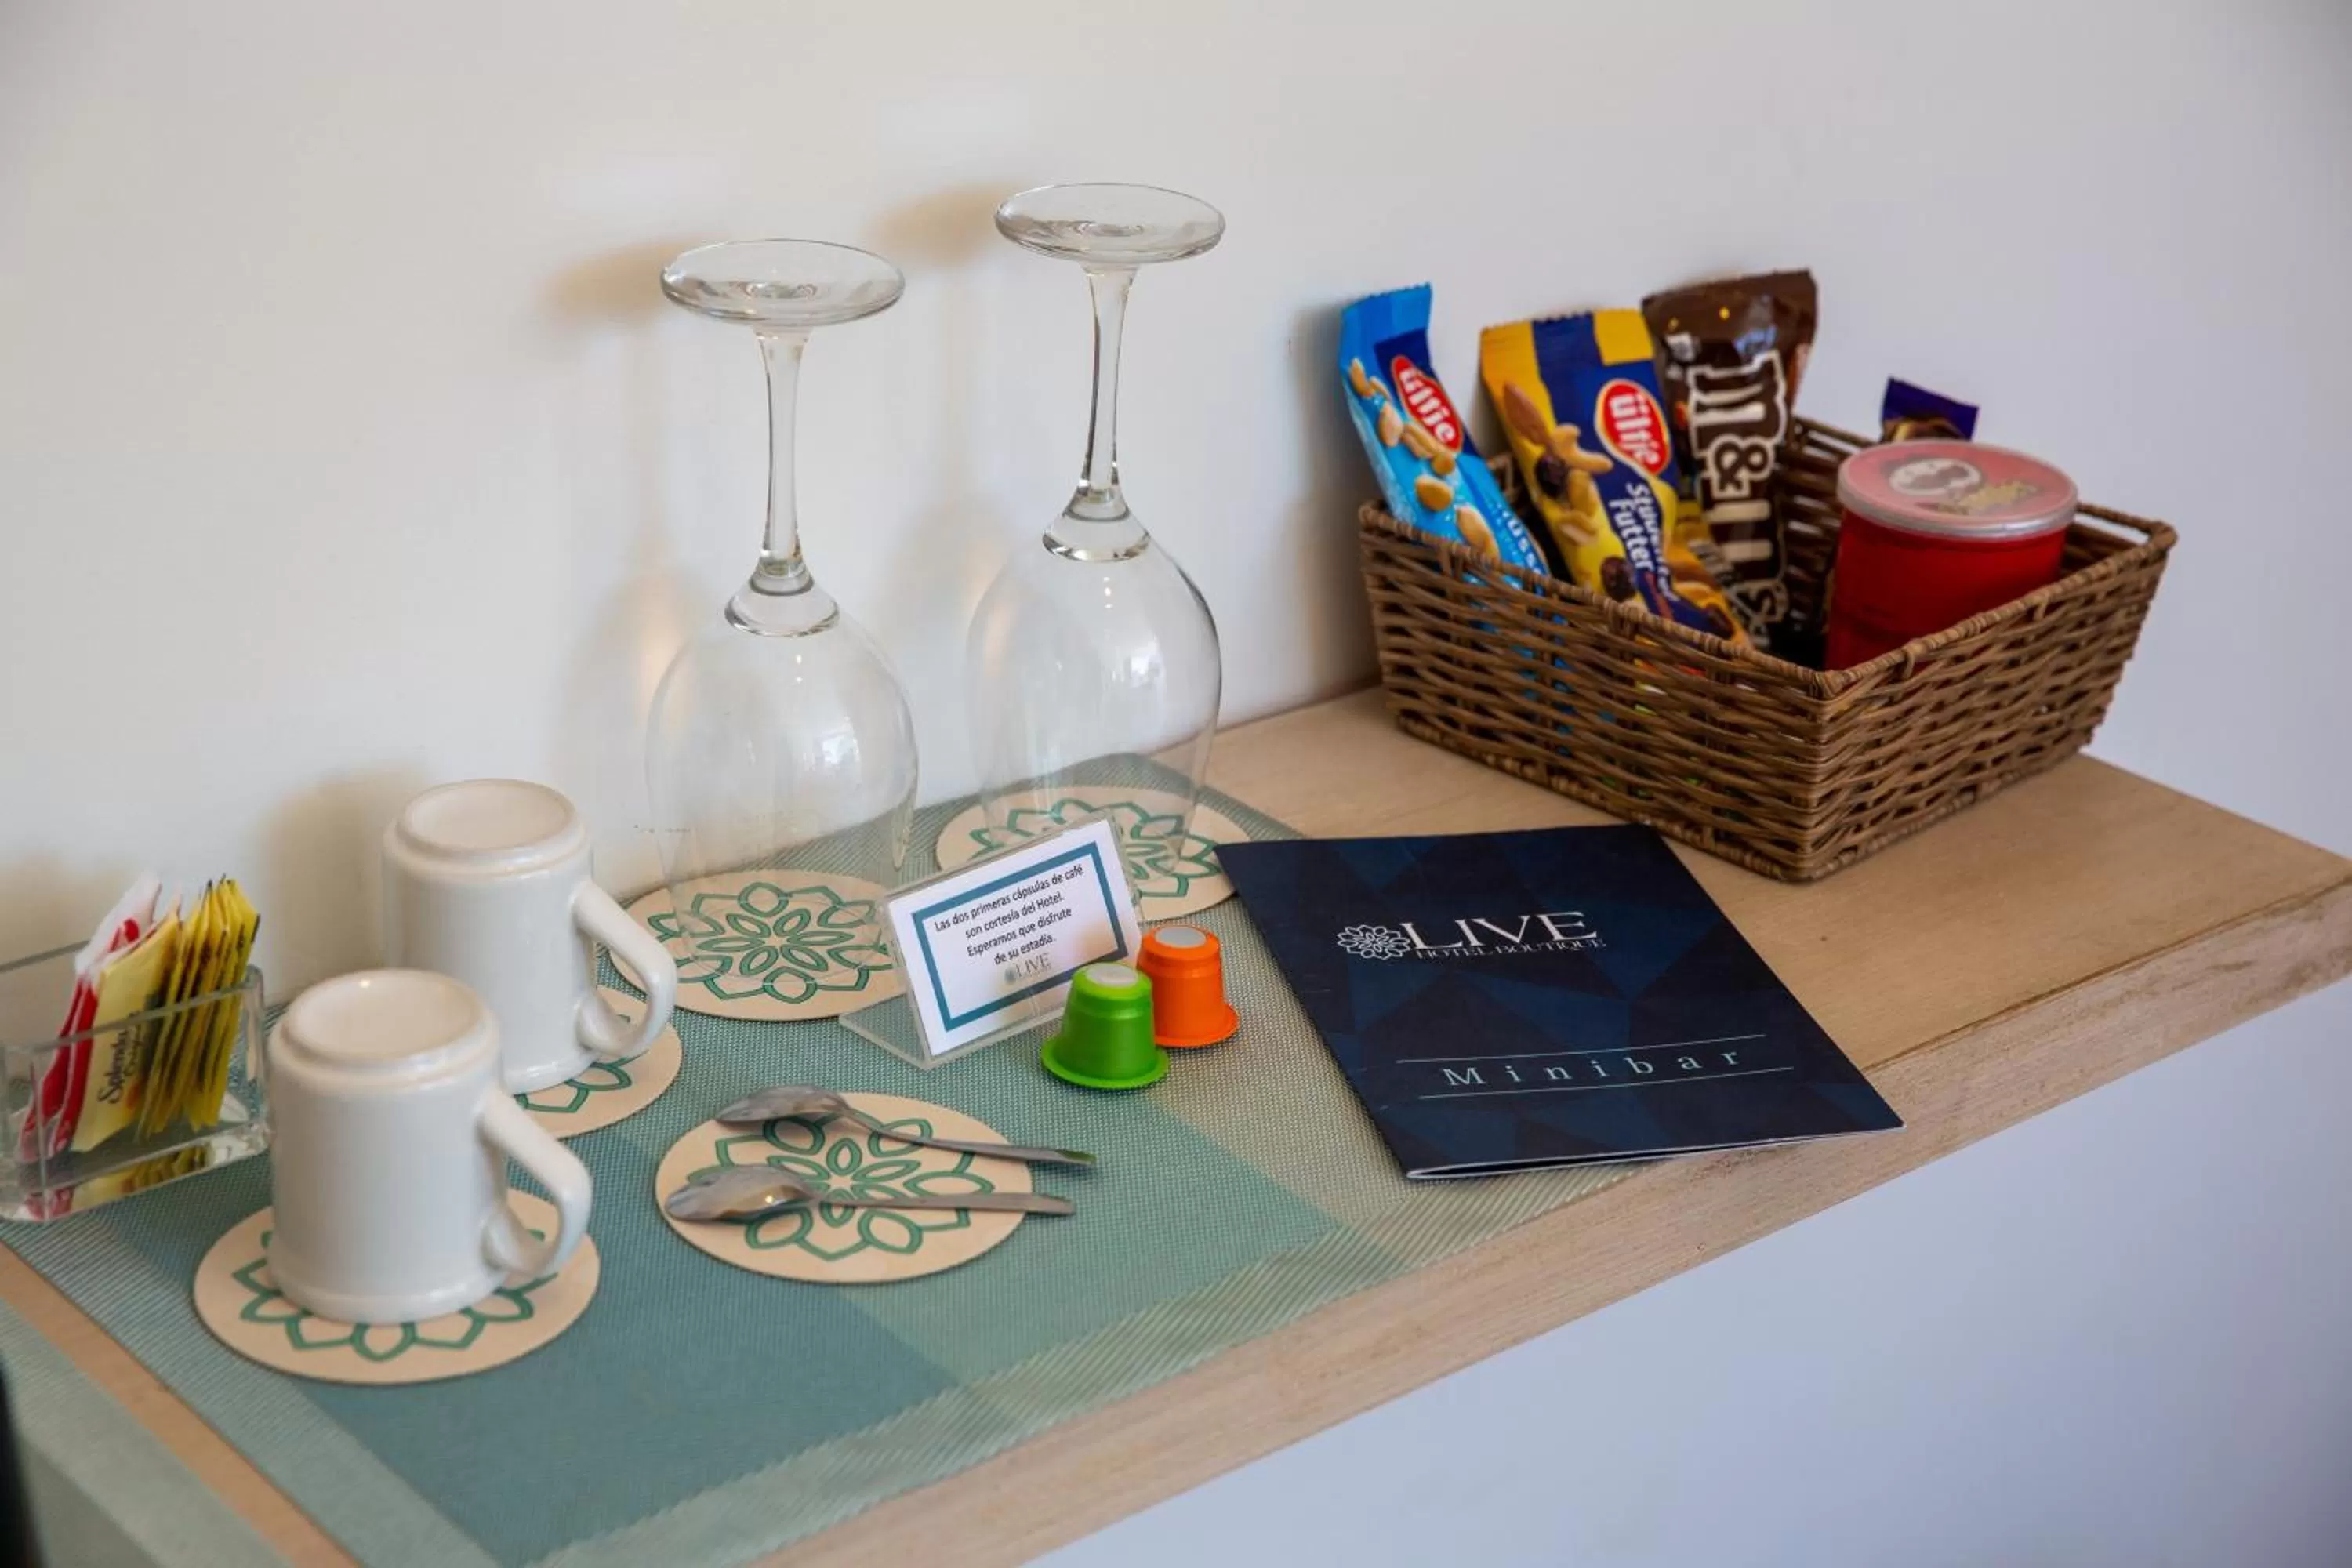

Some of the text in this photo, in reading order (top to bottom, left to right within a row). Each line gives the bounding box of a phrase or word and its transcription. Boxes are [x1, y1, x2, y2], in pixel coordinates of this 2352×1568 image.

[1609, 392, 1661, 465] ültje
[1609, 498, 1656, 572] Futter
[934, 864, 1084, 933] Las dos primeras cápsulas de café
[965, 891, 1065, 939] son cortesía del Hotel.
[967, 907, 1073, 958] Esperamos que disfrute
[1399, 911, 1598, 949] LIVE
[1415, 938, 1606, 960] HOTEL BOUTIQUE
[994, 953, 1007, 965] de
[1007, 947, 1019, 960] su
[1443, 1050, 1741, 1087] Minibar
